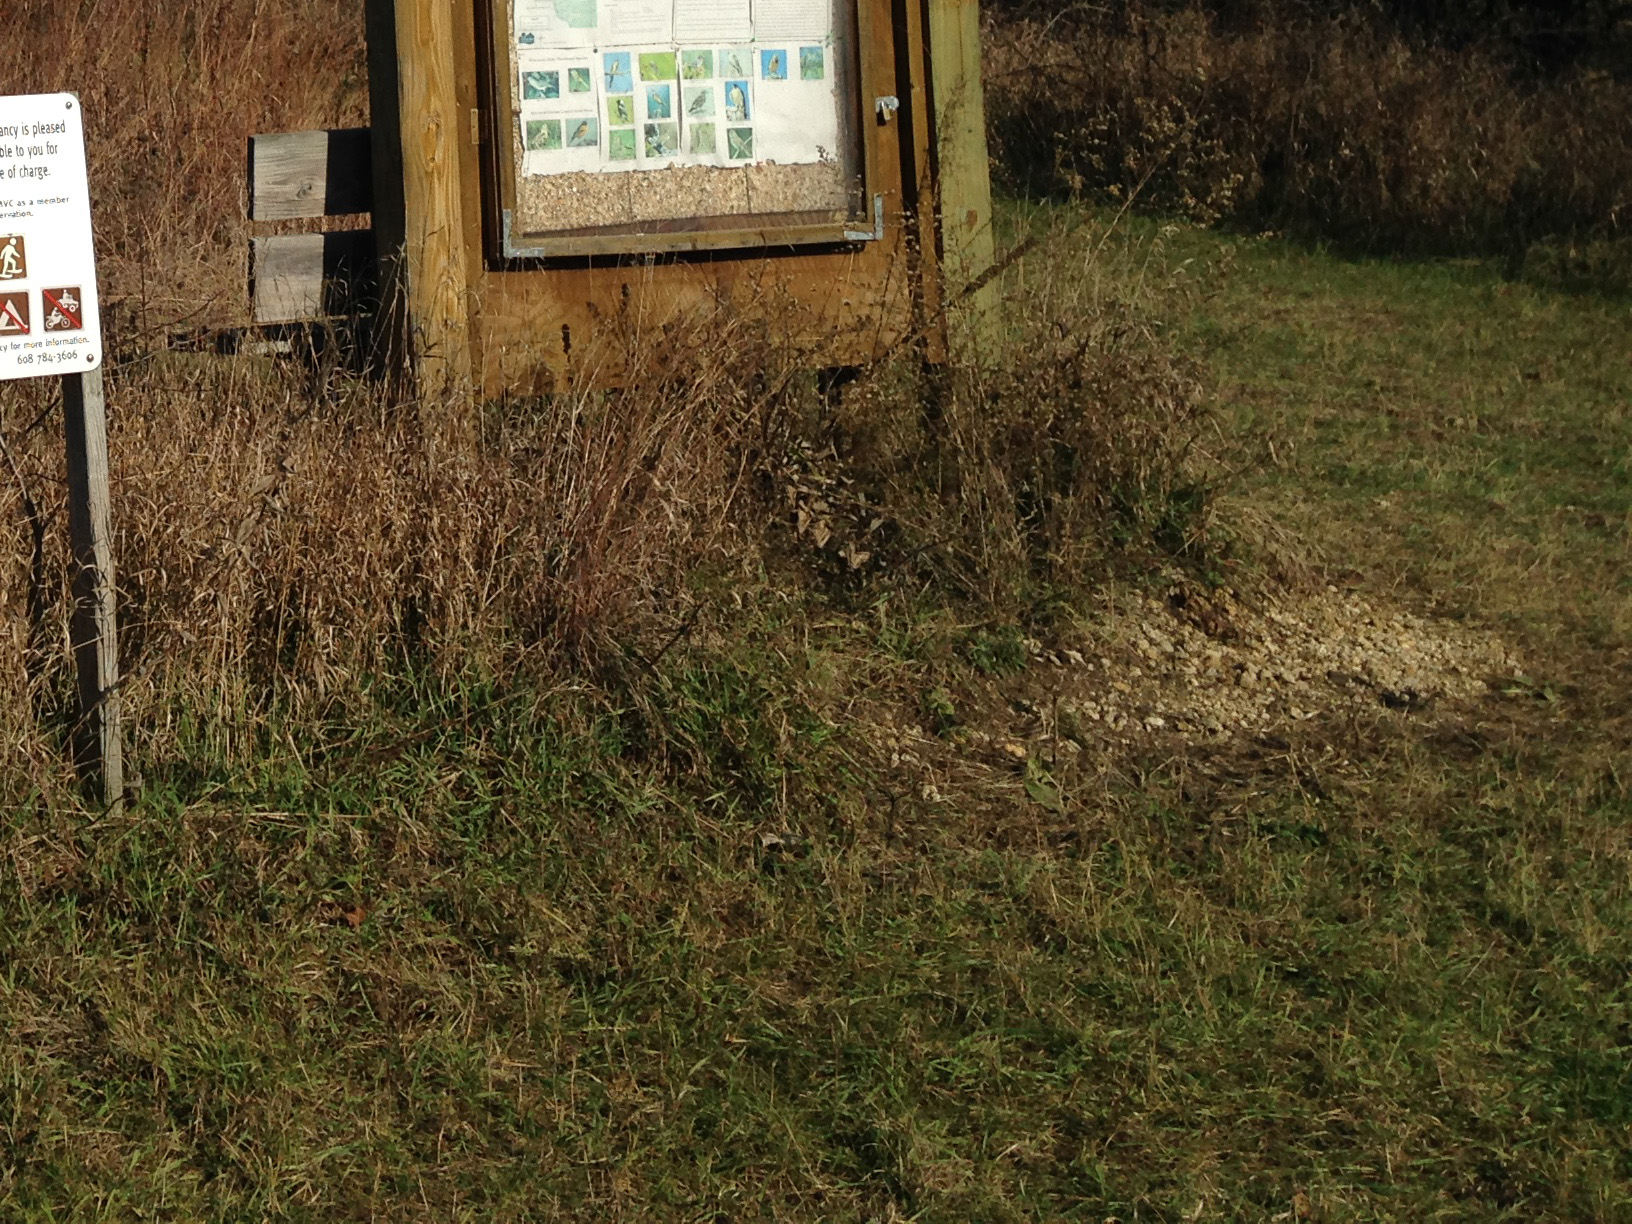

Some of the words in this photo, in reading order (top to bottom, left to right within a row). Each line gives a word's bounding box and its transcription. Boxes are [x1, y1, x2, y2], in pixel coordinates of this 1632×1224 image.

[21, 122, 29, 135] is
[32, 120, 66, 138] pleased
[16, 143, 24, 157] to
[28, 145, 43, 159] you
[46, 141, 58, 155] for
[8, 165, 16, 178] of
[19, 164, 50, 181] charge.
[36, 196, 69, 206] member
[10, 341, 21, 350] for
[24, 341, 43, 349] more
[45, 336, 90, 347] information.
[17, 354, 33, 364] 608
